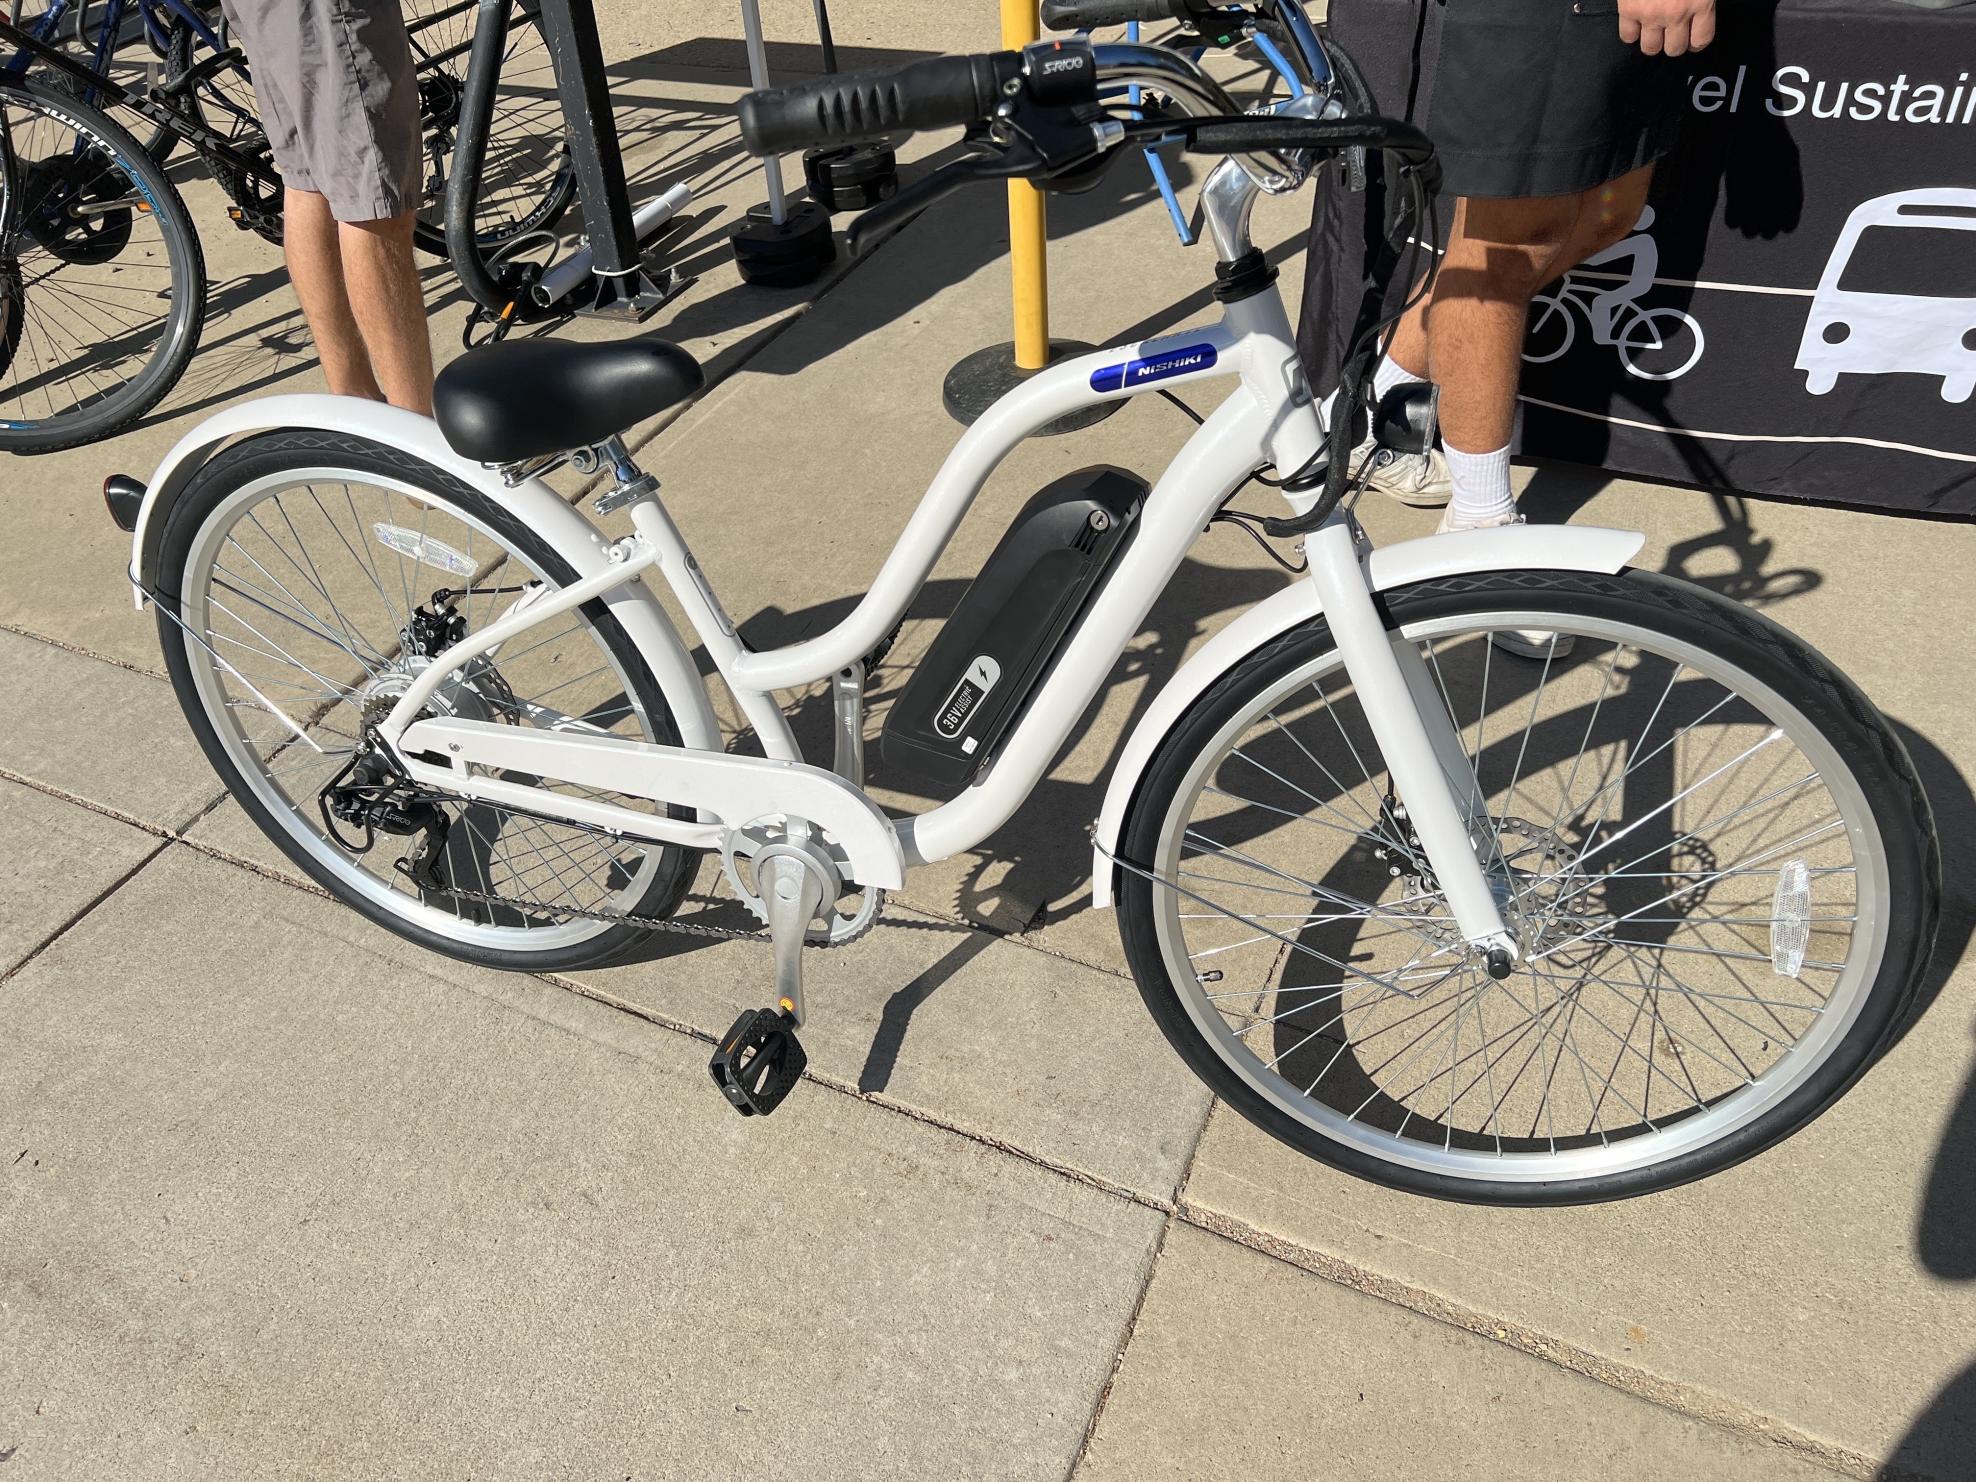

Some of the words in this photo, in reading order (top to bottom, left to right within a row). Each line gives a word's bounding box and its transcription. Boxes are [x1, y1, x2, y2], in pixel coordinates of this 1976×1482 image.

[120, 88, 222, 151] TREK
[1138, 355, 1201, 376] NISHIKI
[942, 707, 962, 729] 36V
[954, 685, 972, 709] ELECTRIC
[960, 695, 973, 714] ASSIST
